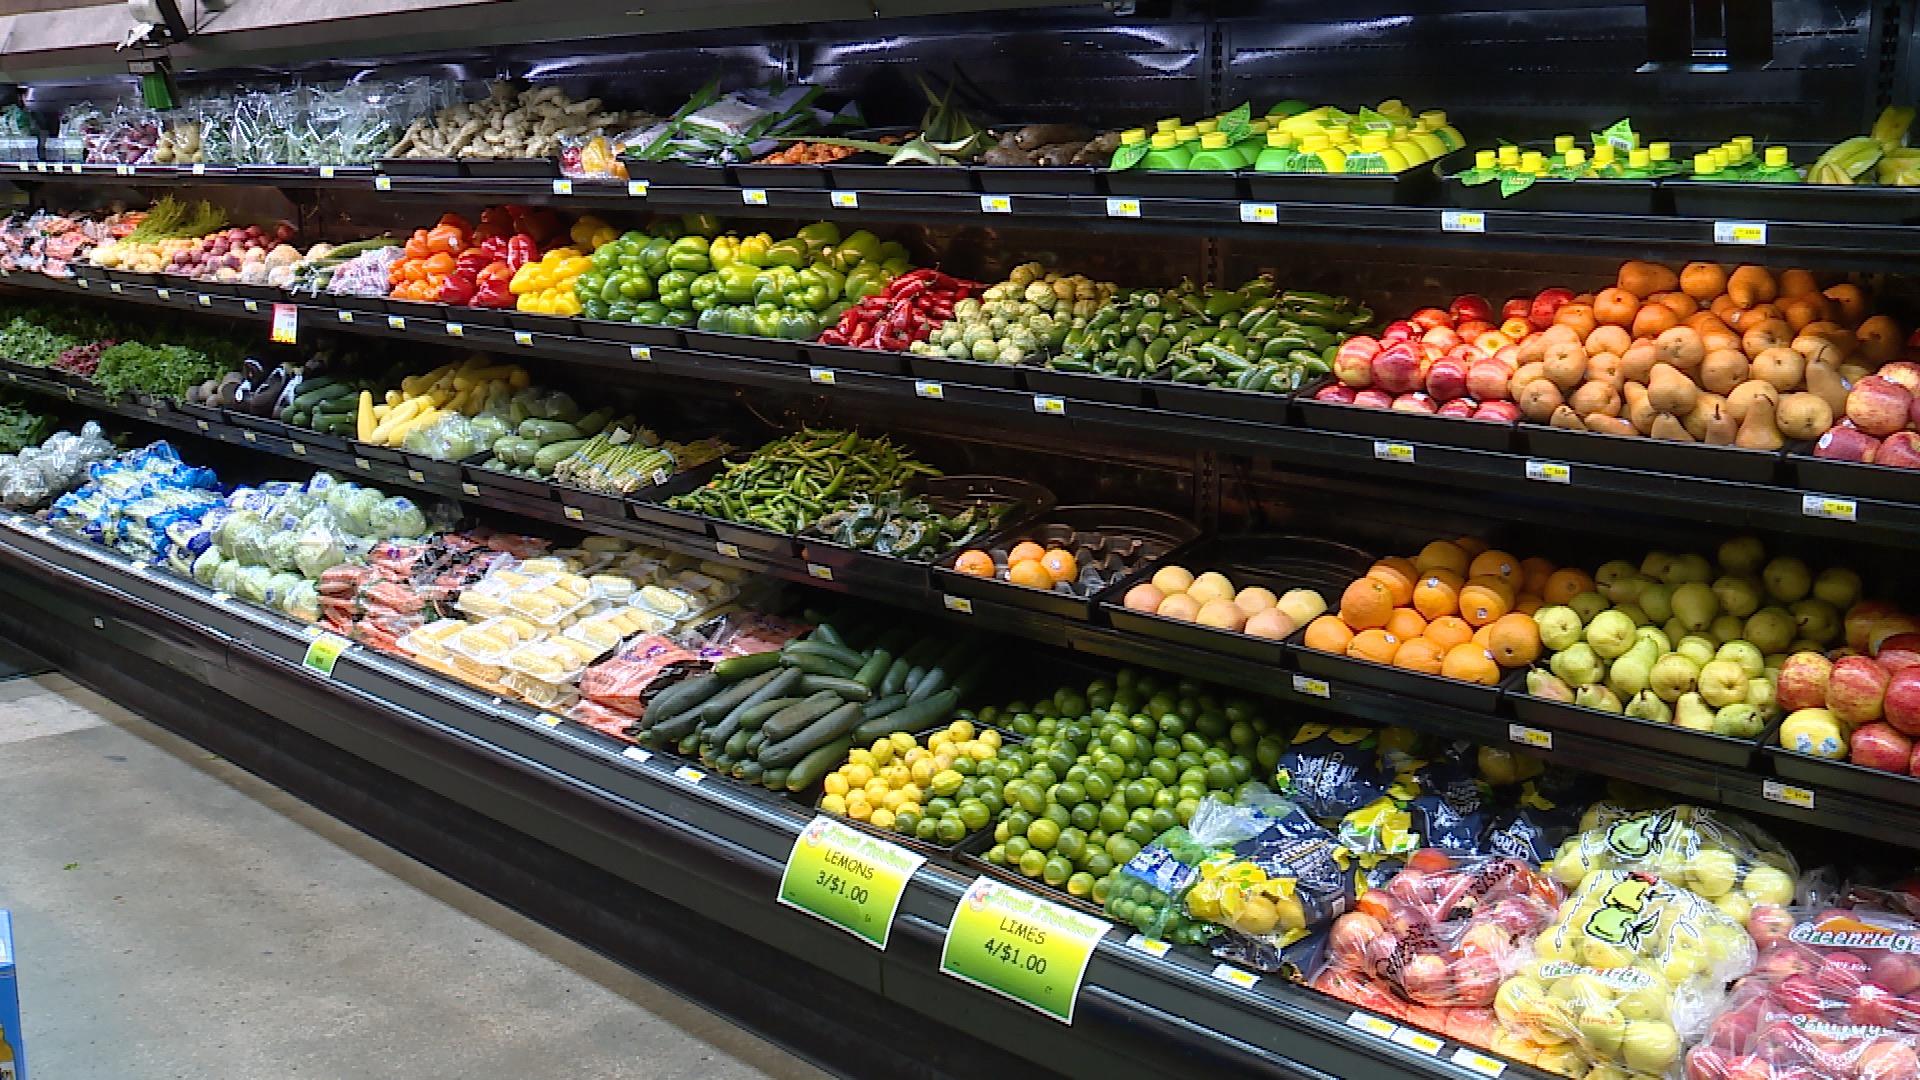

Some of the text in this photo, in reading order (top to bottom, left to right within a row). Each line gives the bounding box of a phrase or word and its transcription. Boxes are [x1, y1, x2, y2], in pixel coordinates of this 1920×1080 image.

[824, 848, 875, 880] LEMONS
[816, 870, 868, 905] 3/$1.00
[999, 916, 1047, 945] LIMES
[1789, 921, 1920, 953] Greenridge
[984, 937, 1047, 975] 4/$1.00
